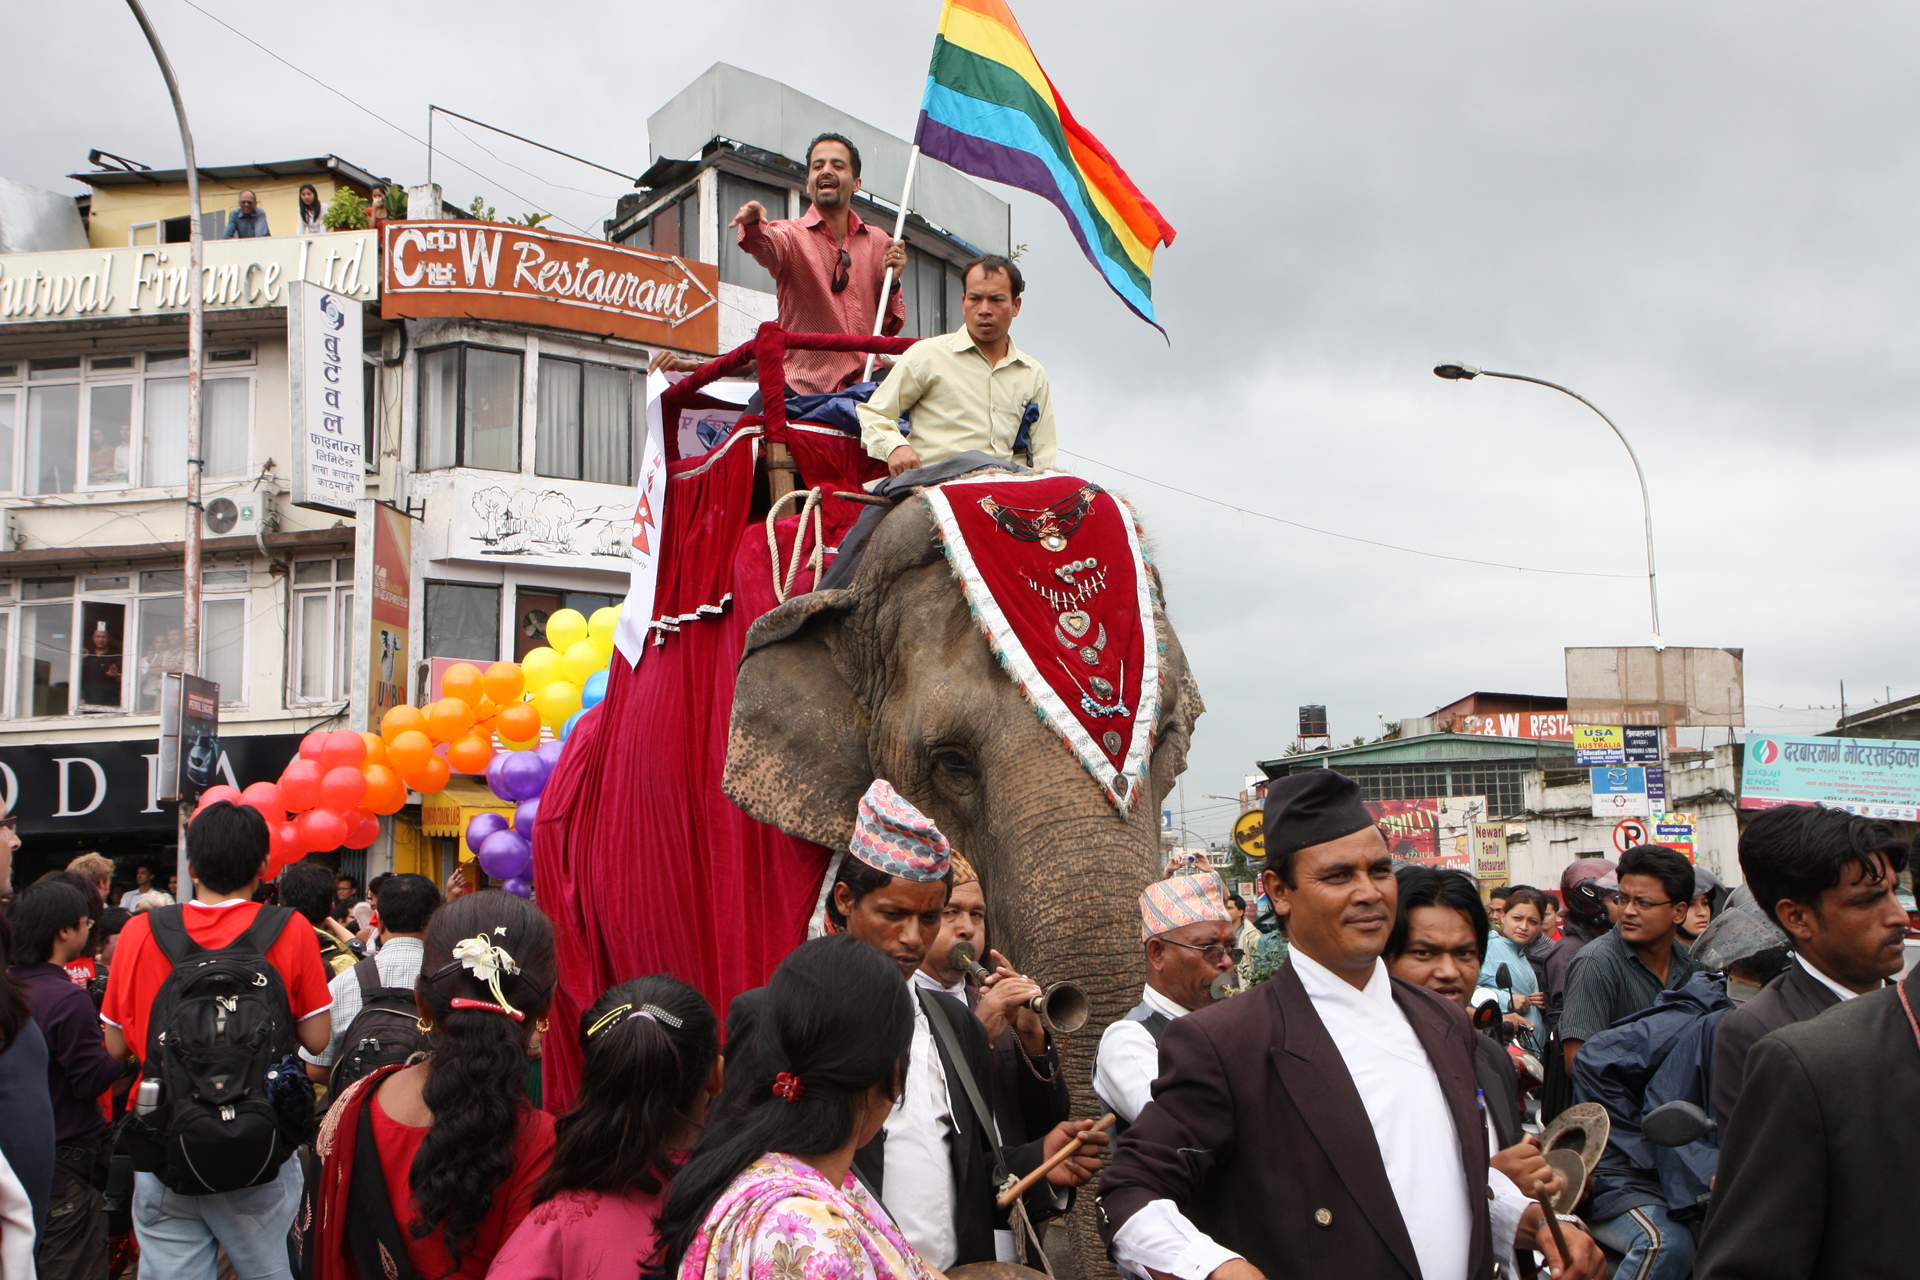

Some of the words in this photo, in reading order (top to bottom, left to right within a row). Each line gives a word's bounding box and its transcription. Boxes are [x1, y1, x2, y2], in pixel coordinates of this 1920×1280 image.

[0, 253, 115, 317] utwal
[128, 252, 281, 311] Finance
[299, 238, 371, 296] Ltd.
[394, 229, 426, 287] C
[460, 229, 502, 289] W
[513, 242, 689, 319] Restaurant
[310, 432, 361, 456] फाइनान्स
[380, 588, 408, 608] EXPRESS
[386, 580, 403, 596] Kodak
[369, 680, 407, 716] JUMBO
[1499, 713, 1520, 737] W
[1784, 739, 1842, 763] दरबारमार्ग
[1844, 739, 1920, 770] मोटरसाईकल
[1746, 778, 1780, 787] ENOC
[1475, 825, 1504, 839] Newari
[1625, 825, 1641, 849] P
[1482, 841, 1499, 857] Family
[1477, 859, 1506, 871] Restaurant
